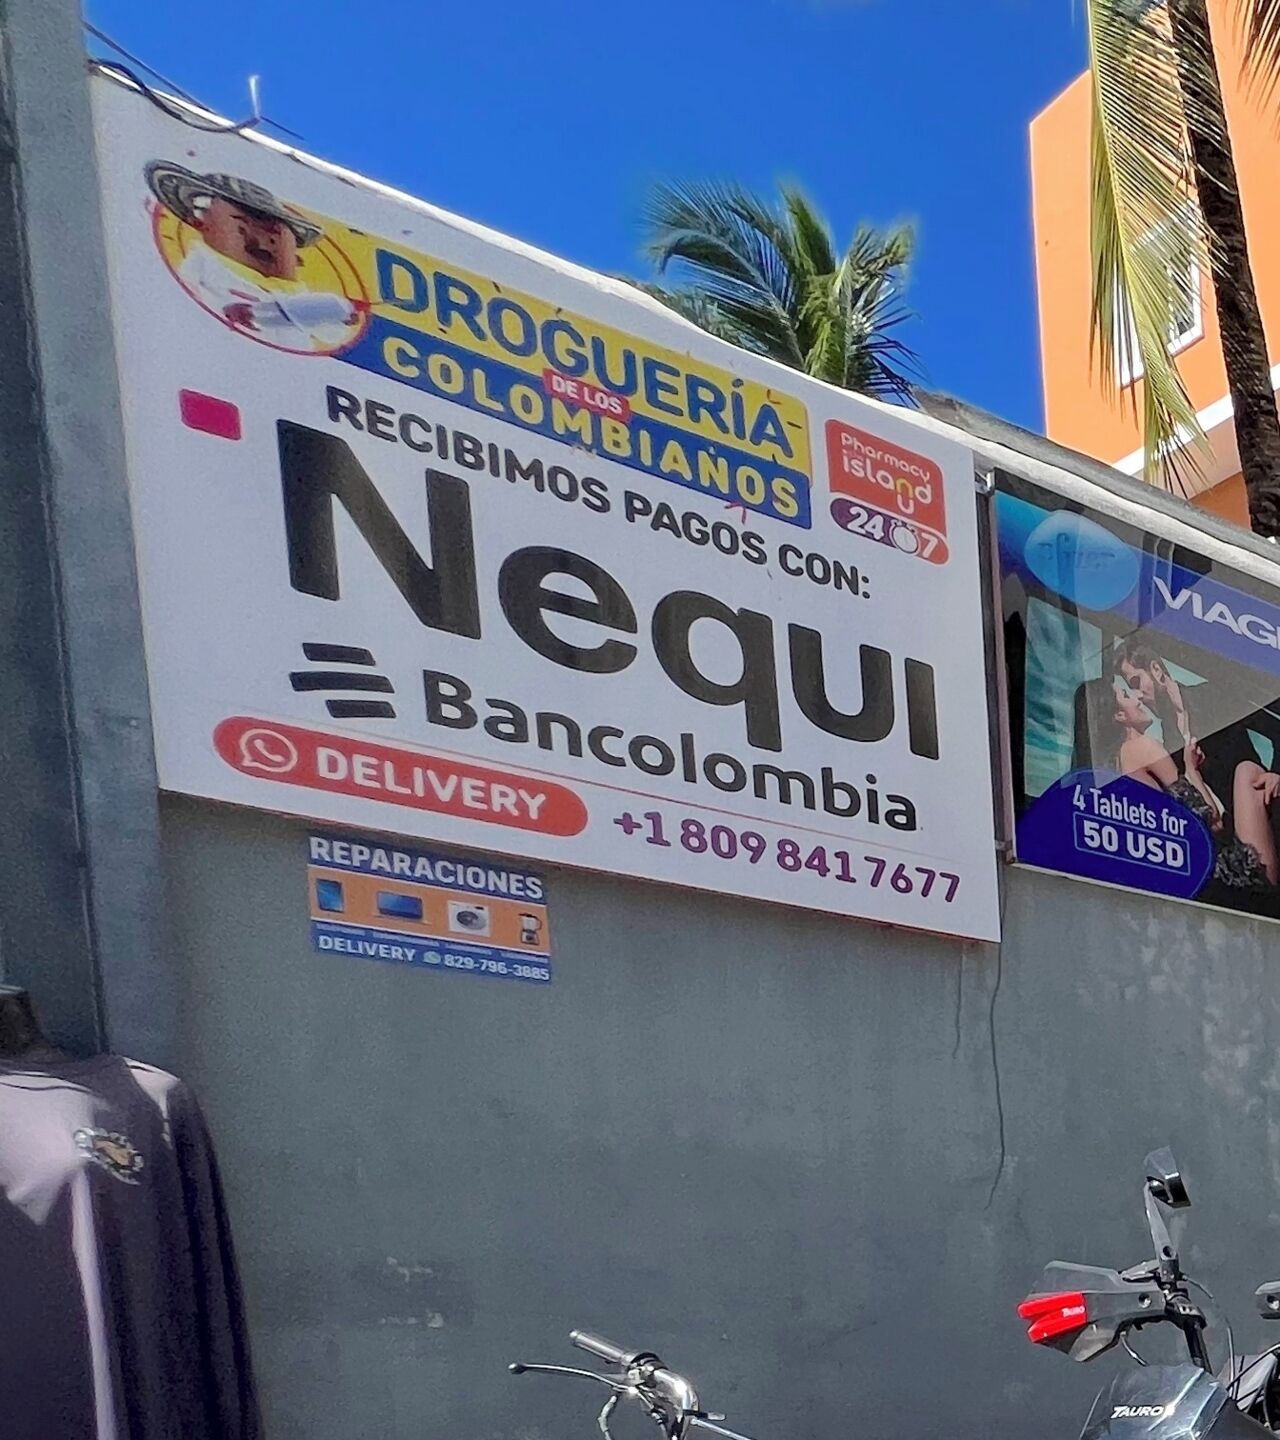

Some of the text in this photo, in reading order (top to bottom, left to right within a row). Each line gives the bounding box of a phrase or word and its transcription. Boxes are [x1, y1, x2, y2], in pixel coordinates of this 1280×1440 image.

[375, 247, 795, 458] DROGUERÍA
[552, 375, 622, 414] DE LOS
[383, 337, 799, 519] COLOMBIANOS
[326, 385, 871, 600] RECIBIMOS PAGOS CON:
[842, 450, 932, 514] island
[847, 506, 938, 559] 24 7
[278, 420, 939, 762] Nequi
[423, 670, 918, 833] Bancolombia
[316, 747, 960, 902] DELIVERY +1 809 841 7677
[1073, 784, 1188, 836] 4 Tablets for
[309, 836, 543, 899] REPARACIONES
[1084, 820, 1184, 868] 50 USD
[318, 935, 416, 963] DELIVERY
[444, 953, 549, 981] 829-796-3885
[1111, 1405, 1161, 1419] TAURO
